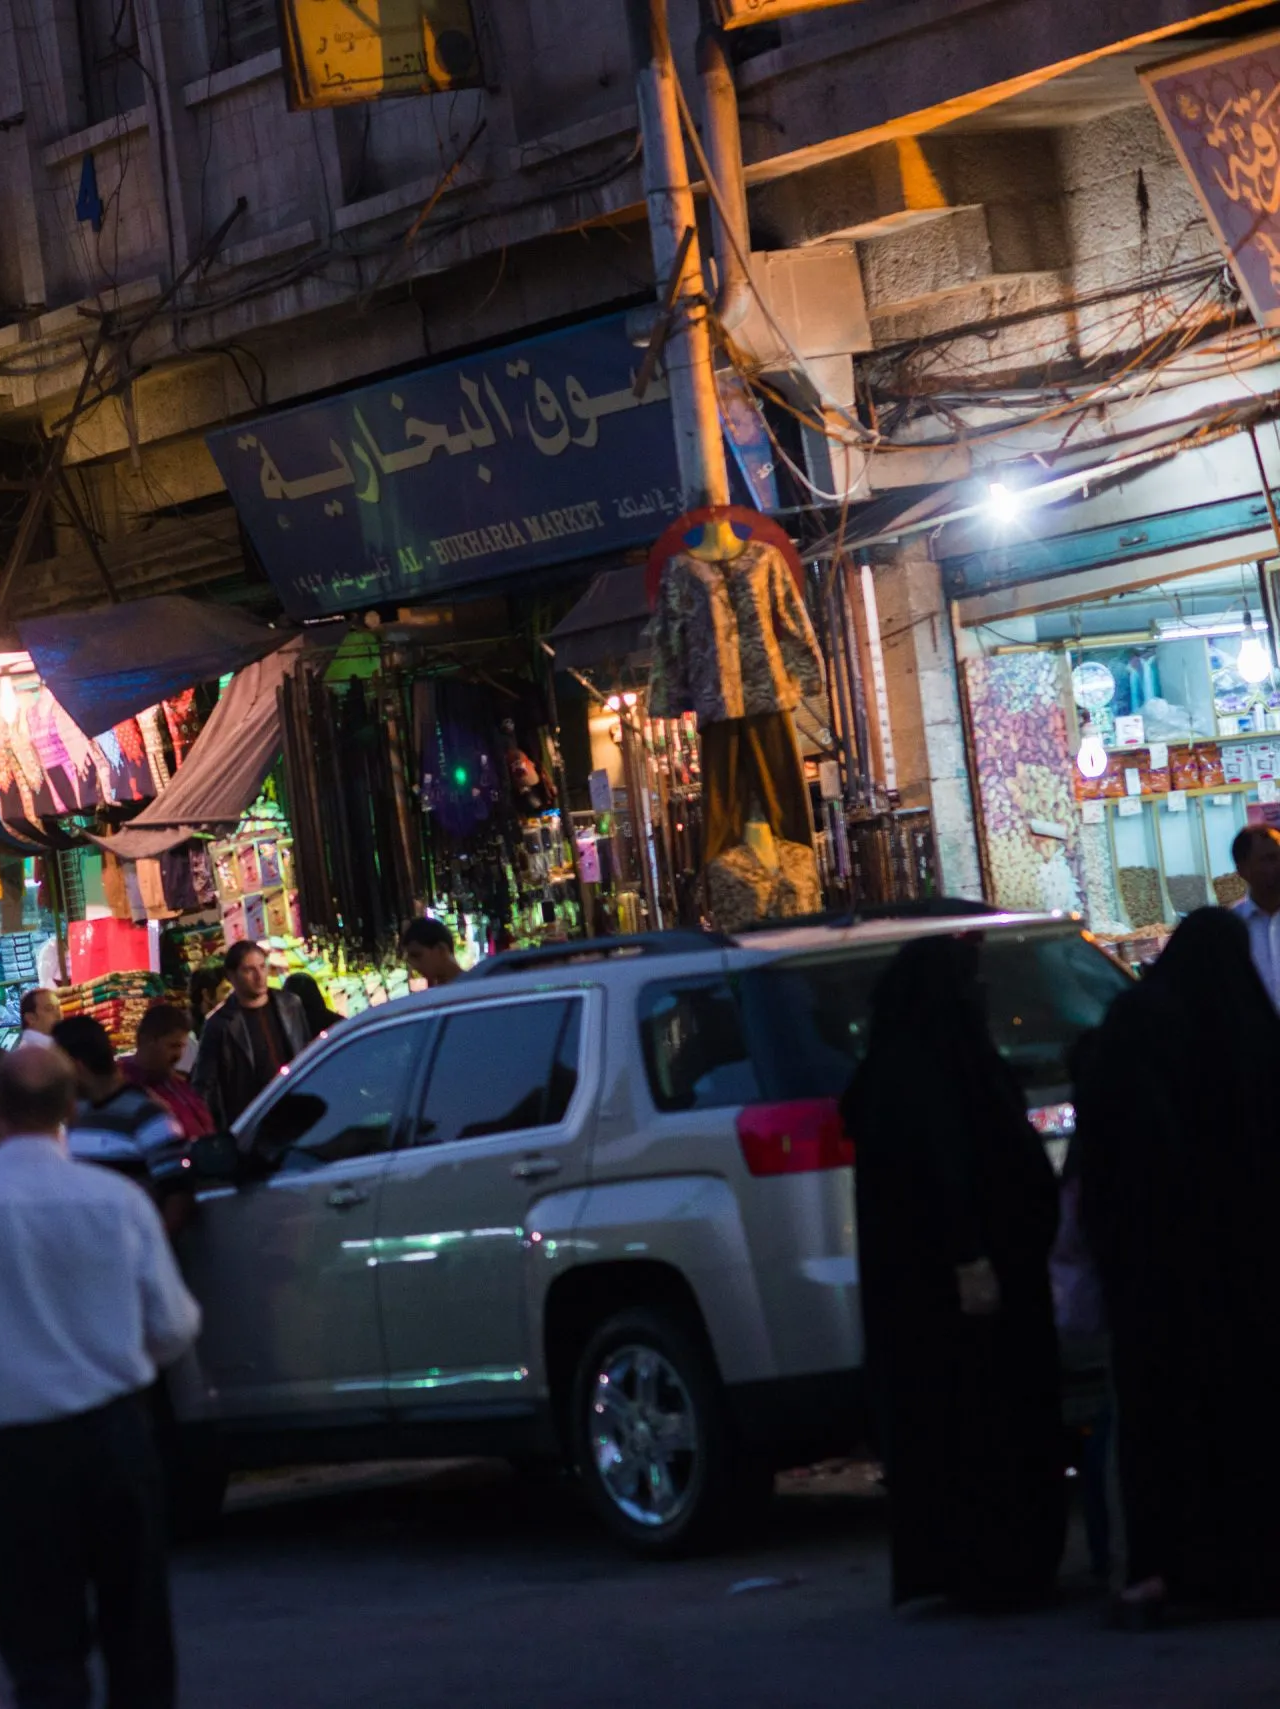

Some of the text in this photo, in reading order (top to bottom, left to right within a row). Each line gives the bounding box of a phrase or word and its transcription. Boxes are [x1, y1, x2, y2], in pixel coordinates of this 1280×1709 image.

[236, 370, 514, 517] البخارية
[397, 546, 424, 574] AL
[431, 518, 527, 566] BUKHARIA
[523, 500, 606, 543] MARKET
